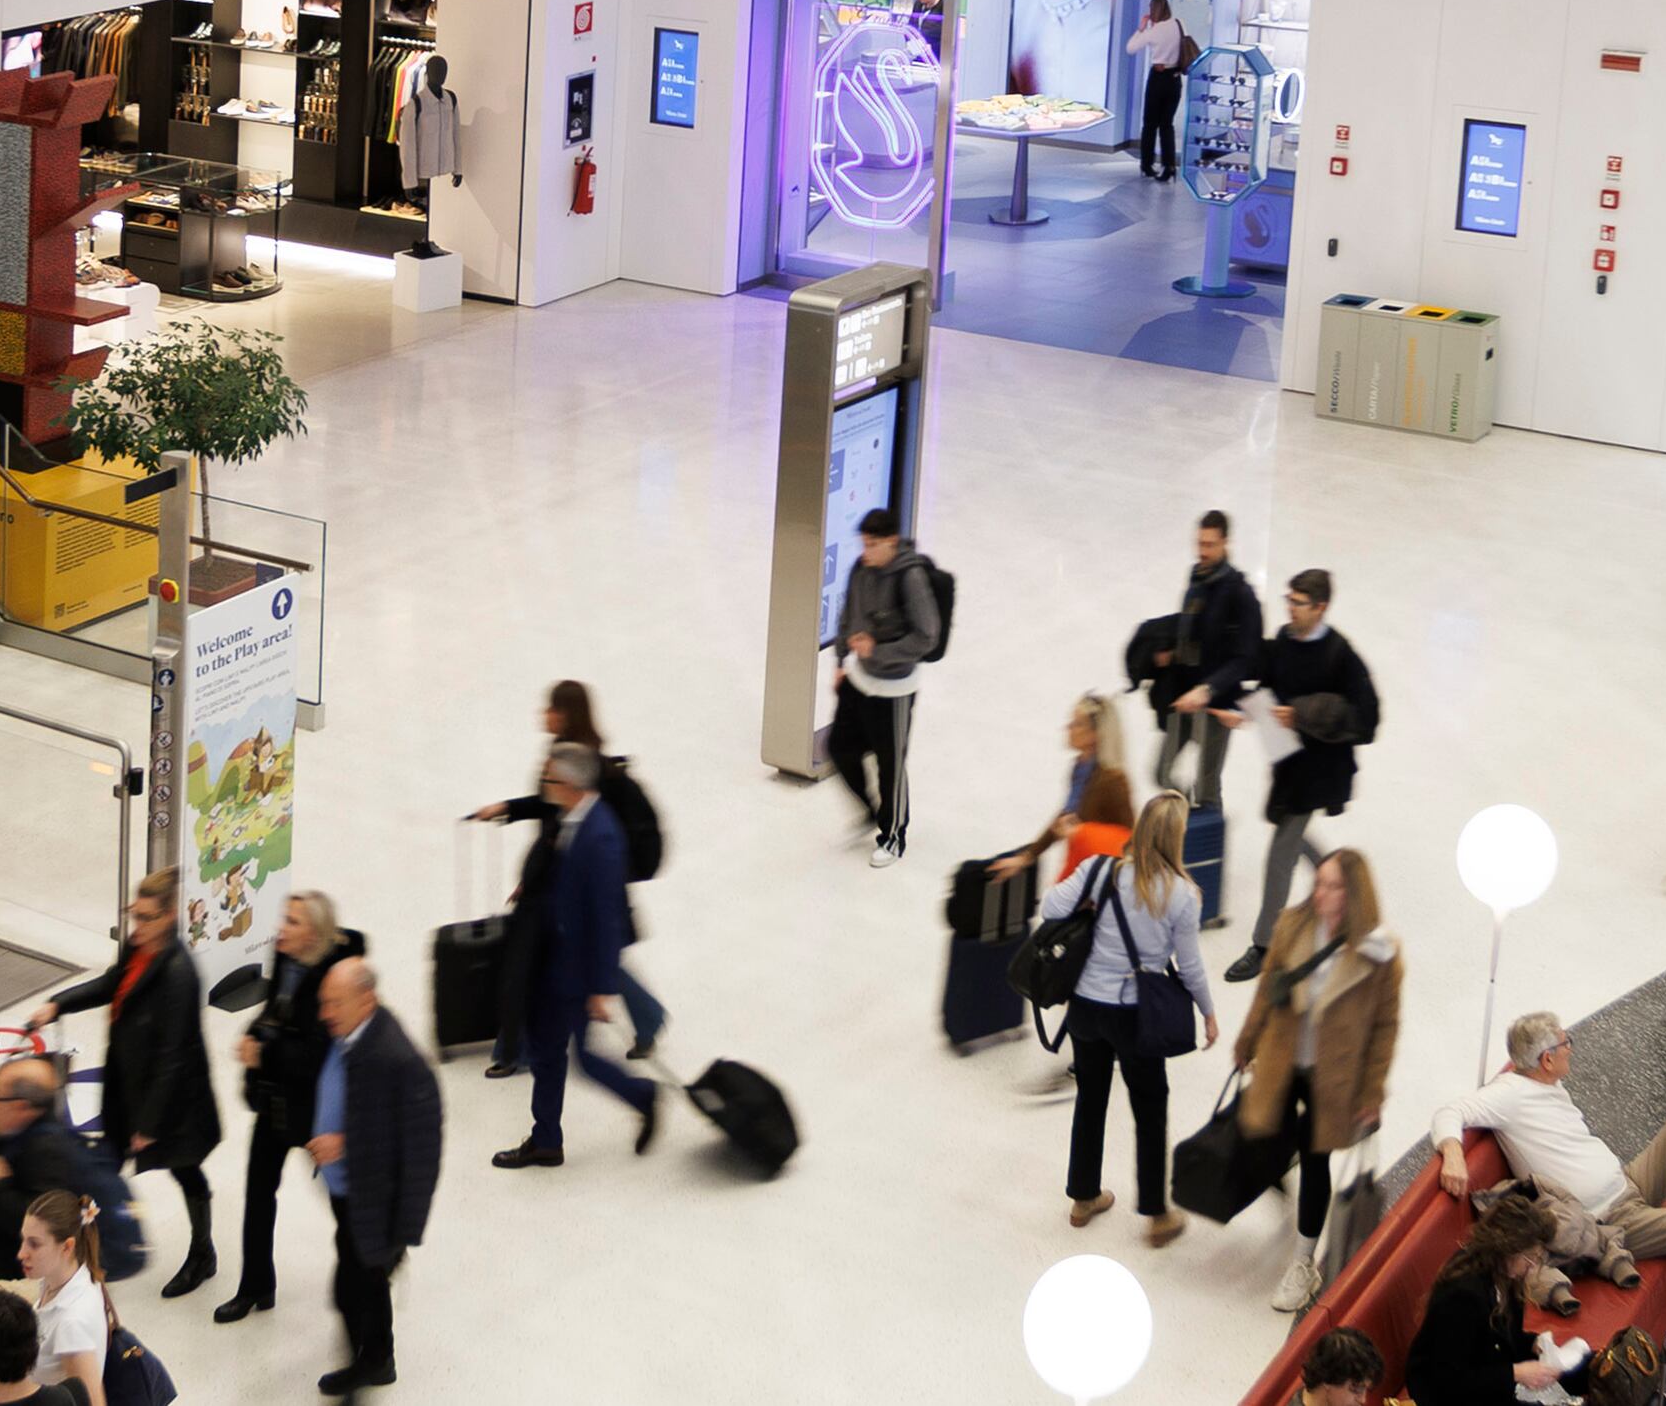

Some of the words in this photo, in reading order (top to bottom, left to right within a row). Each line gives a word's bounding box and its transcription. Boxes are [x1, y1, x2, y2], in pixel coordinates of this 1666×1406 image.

[196, 626, 253, 657] Welcome
[196, 664, 210, 678] to
[212, 654, 232, 671] the
[234, 641, 259, 661] Play
[261, 624, 293, 648] area!
